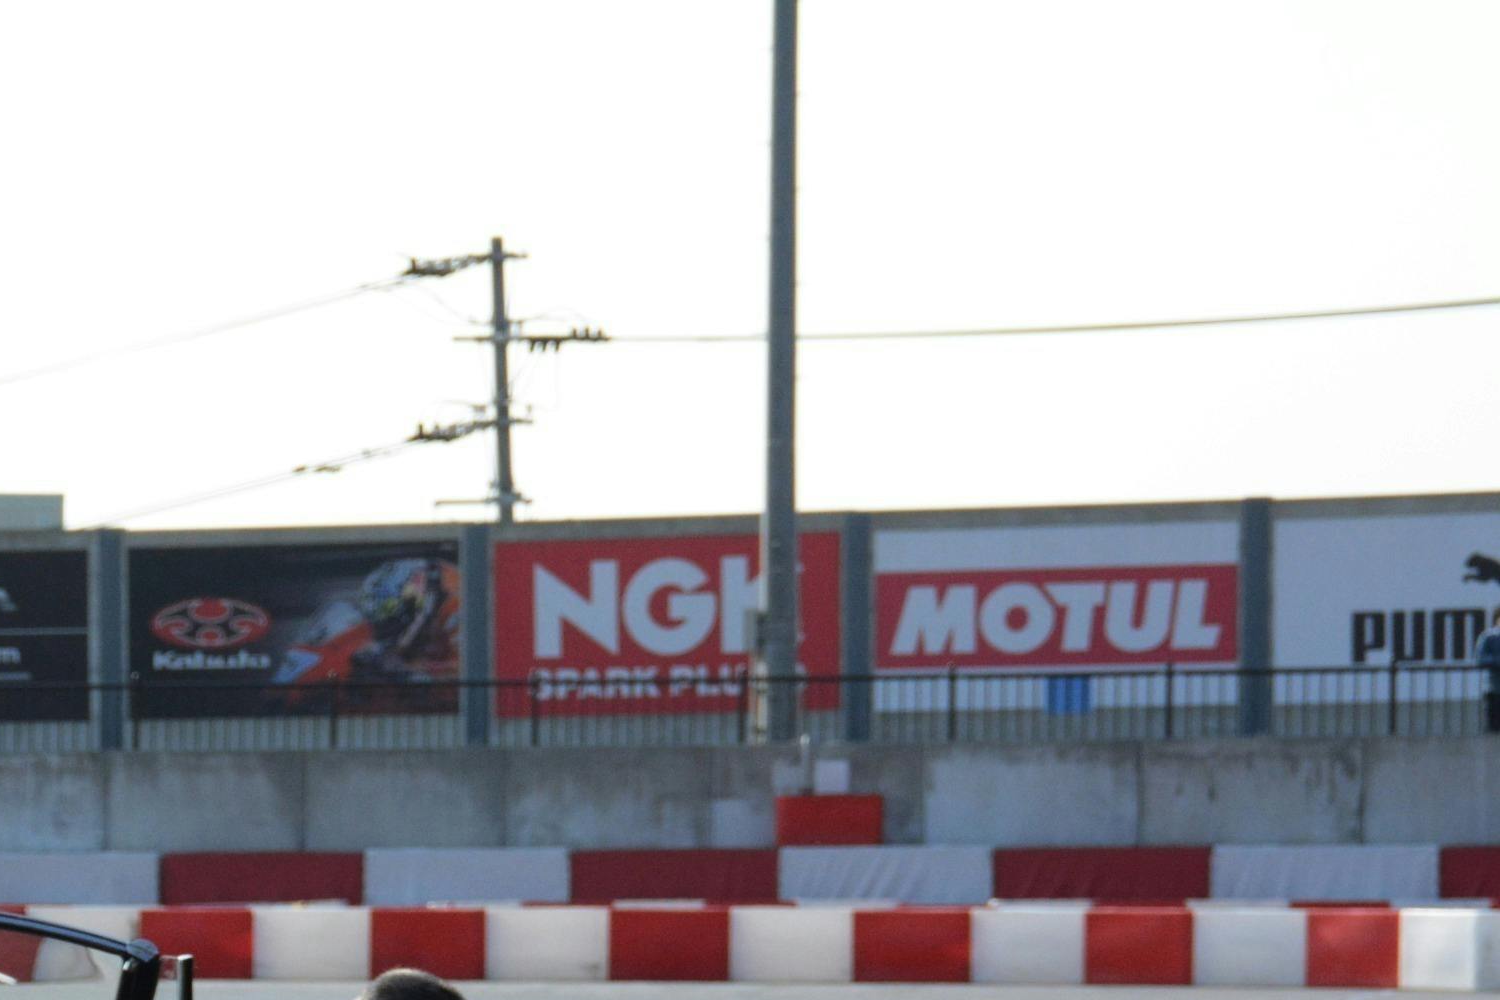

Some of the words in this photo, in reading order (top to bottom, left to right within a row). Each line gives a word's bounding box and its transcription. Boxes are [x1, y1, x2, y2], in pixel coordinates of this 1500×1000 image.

[891, 580, 1221, 655] MOTUL
[1351, 609, 1488, 663] PUM
[534, 666, 661, 702] SPARK
[668, 662, 806, 698] PLU
